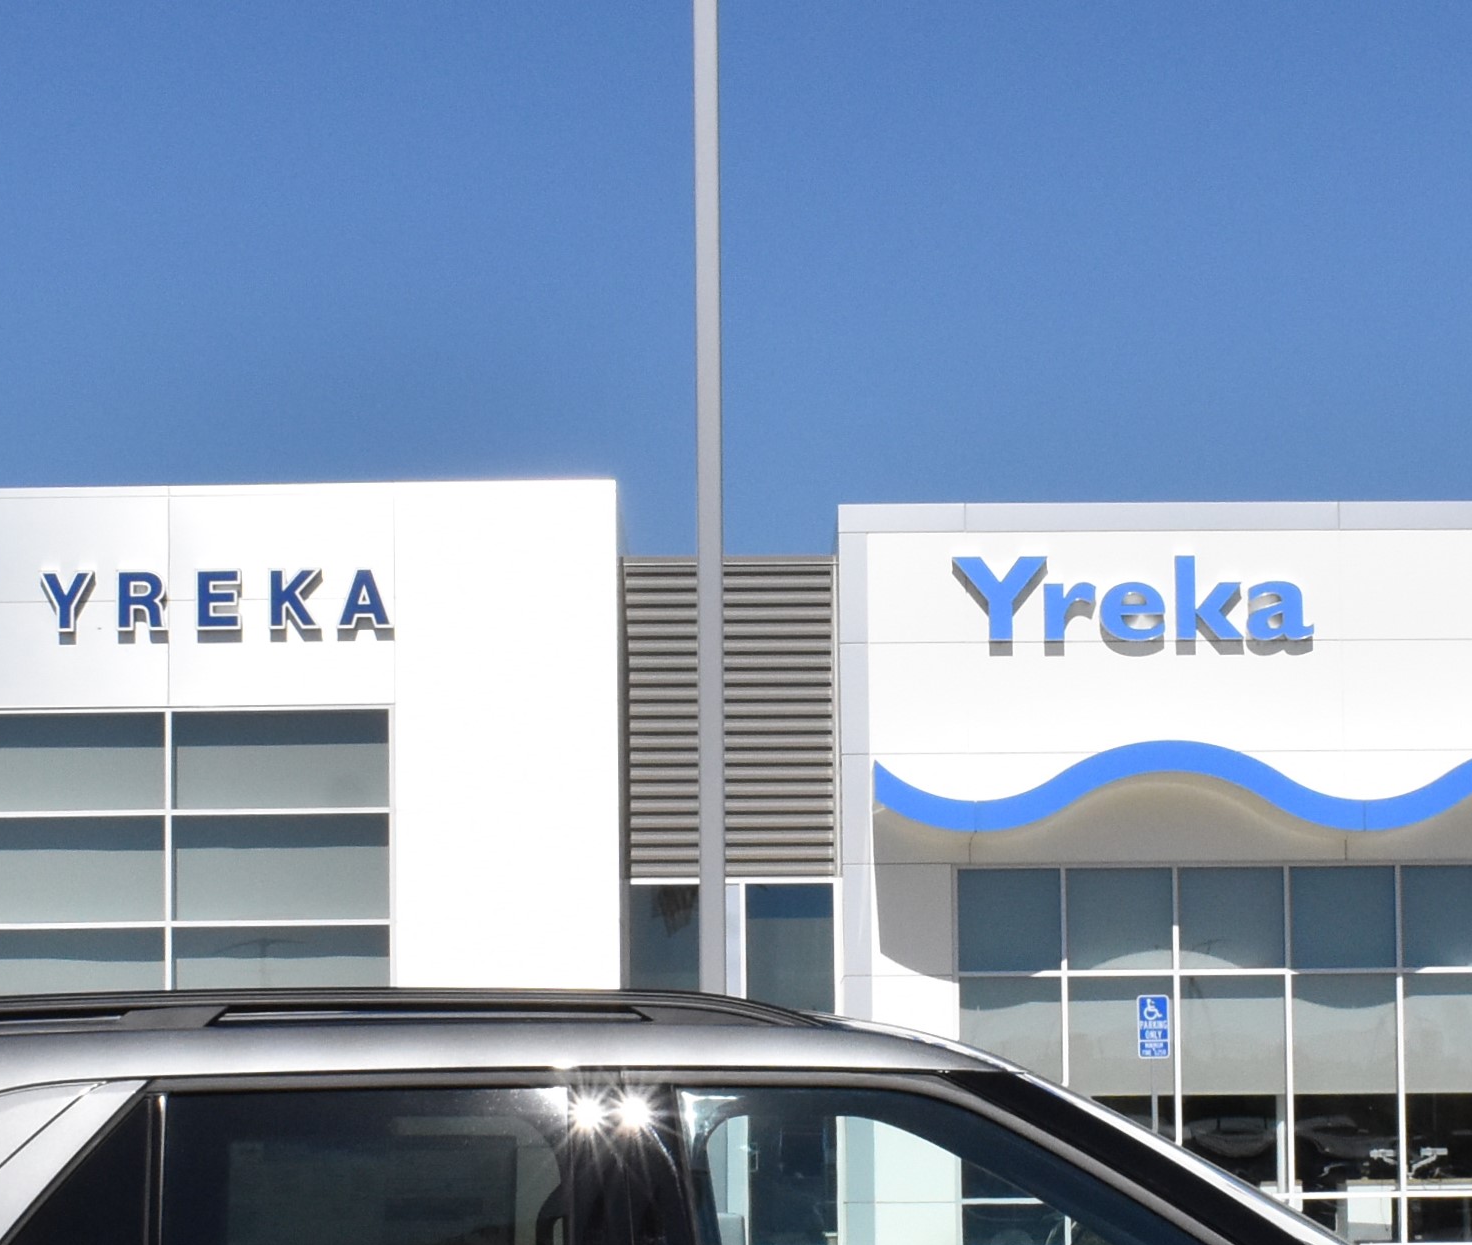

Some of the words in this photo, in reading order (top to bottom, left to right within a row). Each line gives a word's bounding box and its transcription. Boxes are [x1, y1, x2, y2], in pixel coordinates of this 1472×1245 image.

[42, 569, 392, 632] YREKA
[952, 555, 1314, 641] Yreka
[1140, 1020, 1168, 1029] PARKING
[1144, 1029, 1163, 1039] ONLY
